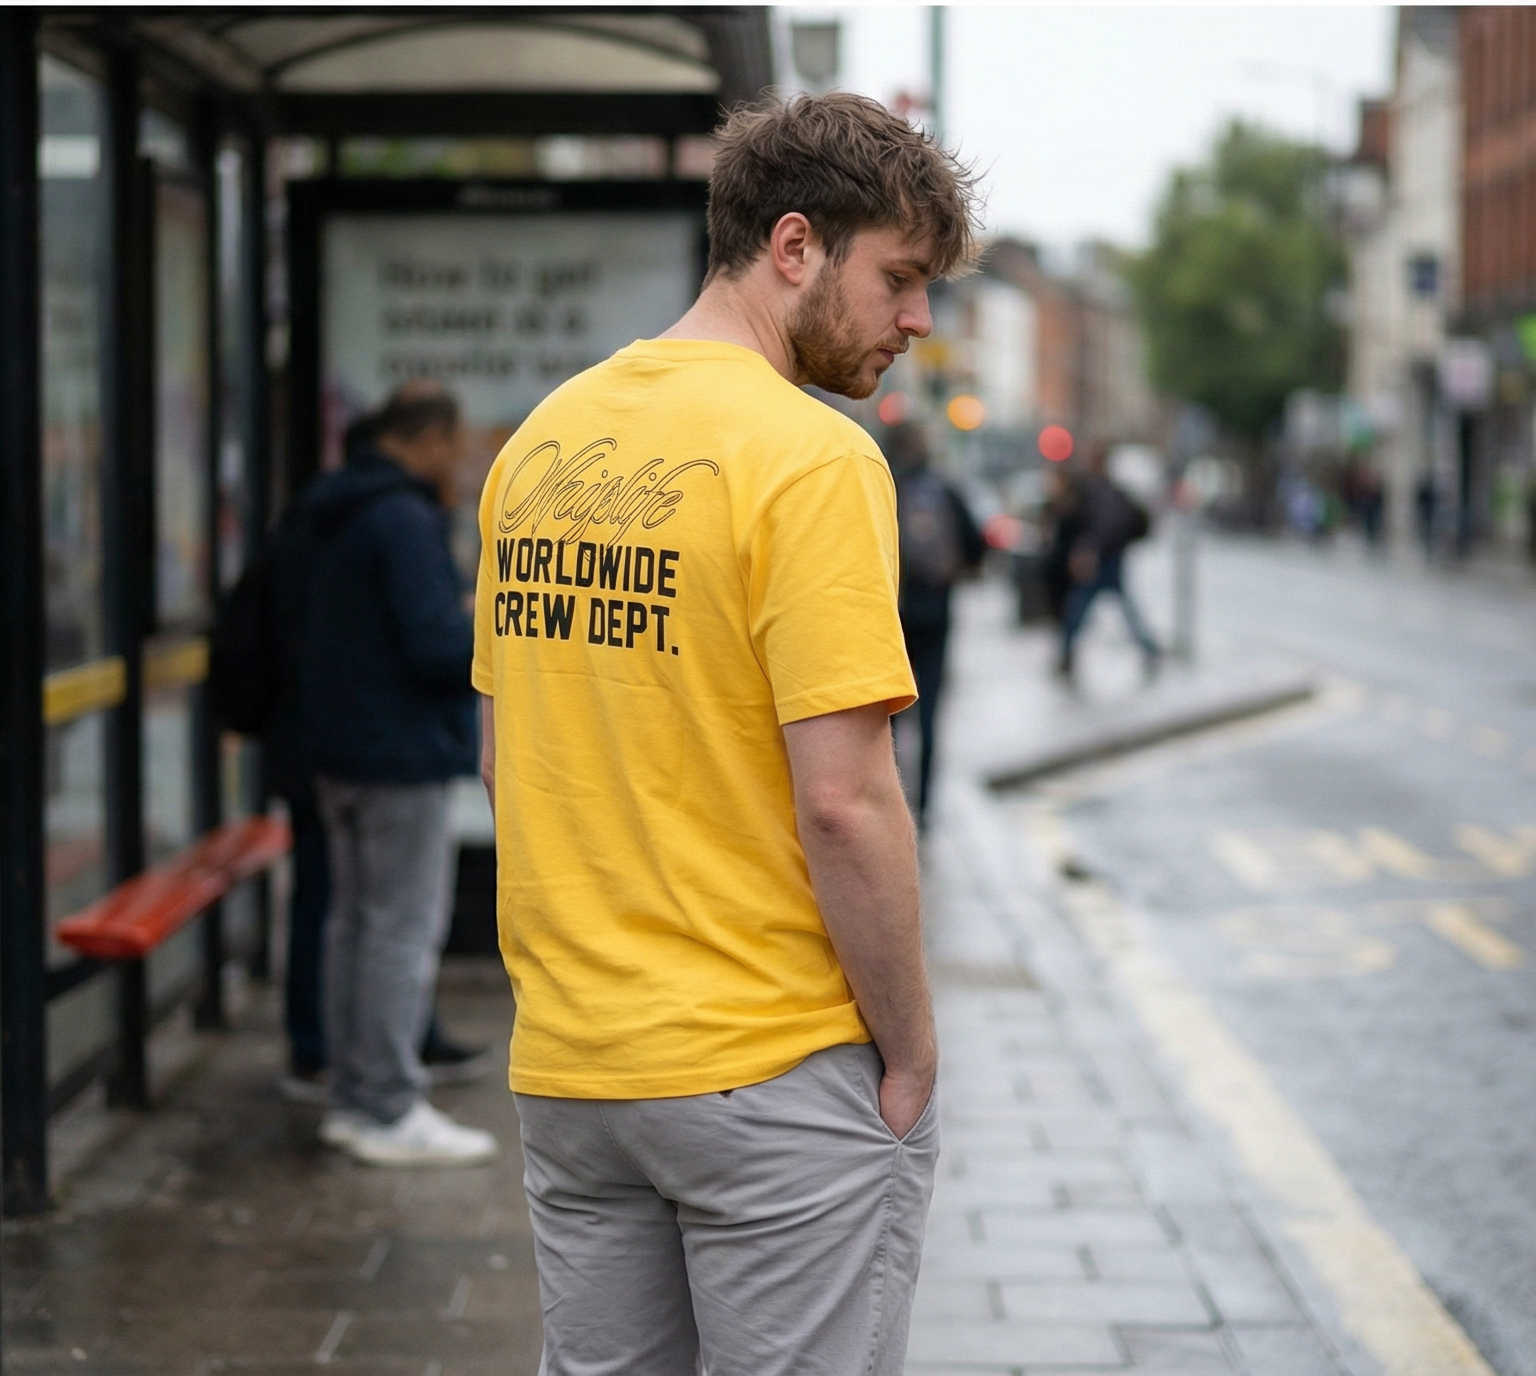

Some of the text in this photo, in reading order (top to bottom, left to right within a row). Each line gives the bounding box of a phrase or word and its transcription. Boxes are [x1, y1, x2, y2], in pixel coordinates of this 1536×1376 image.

[497, 537, 680, 598] WORLDWIDE
[494, 590, 679, 656] CREW DEPT.
